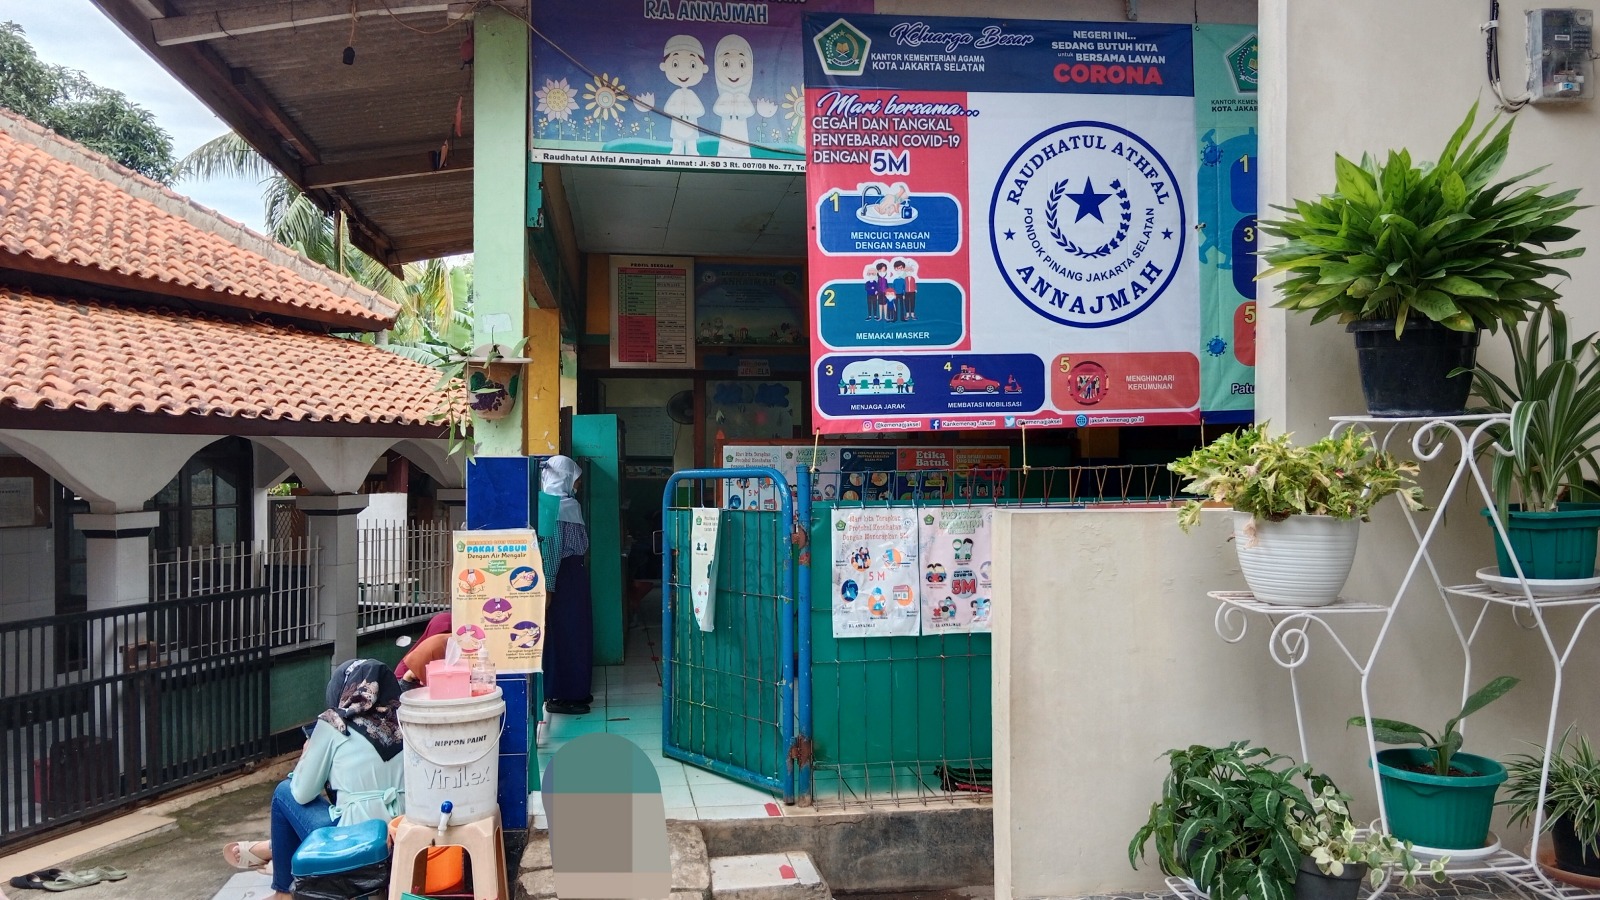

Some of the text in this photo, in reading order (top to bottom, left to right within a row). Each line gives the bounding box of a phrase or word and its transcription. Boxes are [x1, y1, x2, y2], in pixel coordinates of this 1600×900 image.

[645, 0, 767, 24] R.A. ANNAJMAH
[890, 21, 1035, 53] Keluarga Besar
[1073, 30, 1136, 40] NEGERI INI...
[1051, 41, 1158, 52] SEDANG BUTUH KITA
[871, 53, 985, 63] KANTOR KEMENTERIAN AGAMA
[1076, 53, 1126, 63] BERSAMA
[1128, 55, 1166, 64] LAWAN
[872, 62, 985, 72] KOTA JAKARTA SELATAN
[1053, 63, 1163, 85] CORONA
[817, 91, 979, 118] Mari bersama...
[812, 117, 953, 131] CEGAH DAN TANGKAL
[813, 133, 961, 147] PENYEBARAN COVID-19
[543, 152, 661, 166] Raudhatul Athfal Annajmah
[666, 159, 693, 167] Alamat
[813, 150, 908, 174] DENGAN 5M
[1239, 154, 1249, 173] 1
[1007, 135, 1169, 205] RAUDHATUL ATHFAL
[829, 192, 841, 212] 1
[851, 231, 930, 240] MENCUCI TANGAN
[1243, 227, 1255, 242] 3
[855, 241, 926, 250] DENGAN SABUN
[1024, 207, 1154, 282] PONDOK PINANG JAKARTA SELATAN
[1016, 260, 1163, 314] ANNAJMAH
[823, 289, 836, 307] 2
[1244, 305, 1256, 324] 5
[856, 331, 930, 340] MEMAKAI MASKER
[825, 364, 834, 376] 3
[943, 361, 952, 372] 4
[1059, 357, 1071, 373] 5
[1125, 374, 1175, 382] MENGHINDARI
[916, 450, 946, 459] Etika
[916, 459, 950, 467] Batuk
[466, 544, 527, 553] PAKAI SABUN
[951, 579, 977, 595] 5M
[435, 734, 487, 747] NIPPON PAINT
[424, 766, 491, 790] Vinilex
